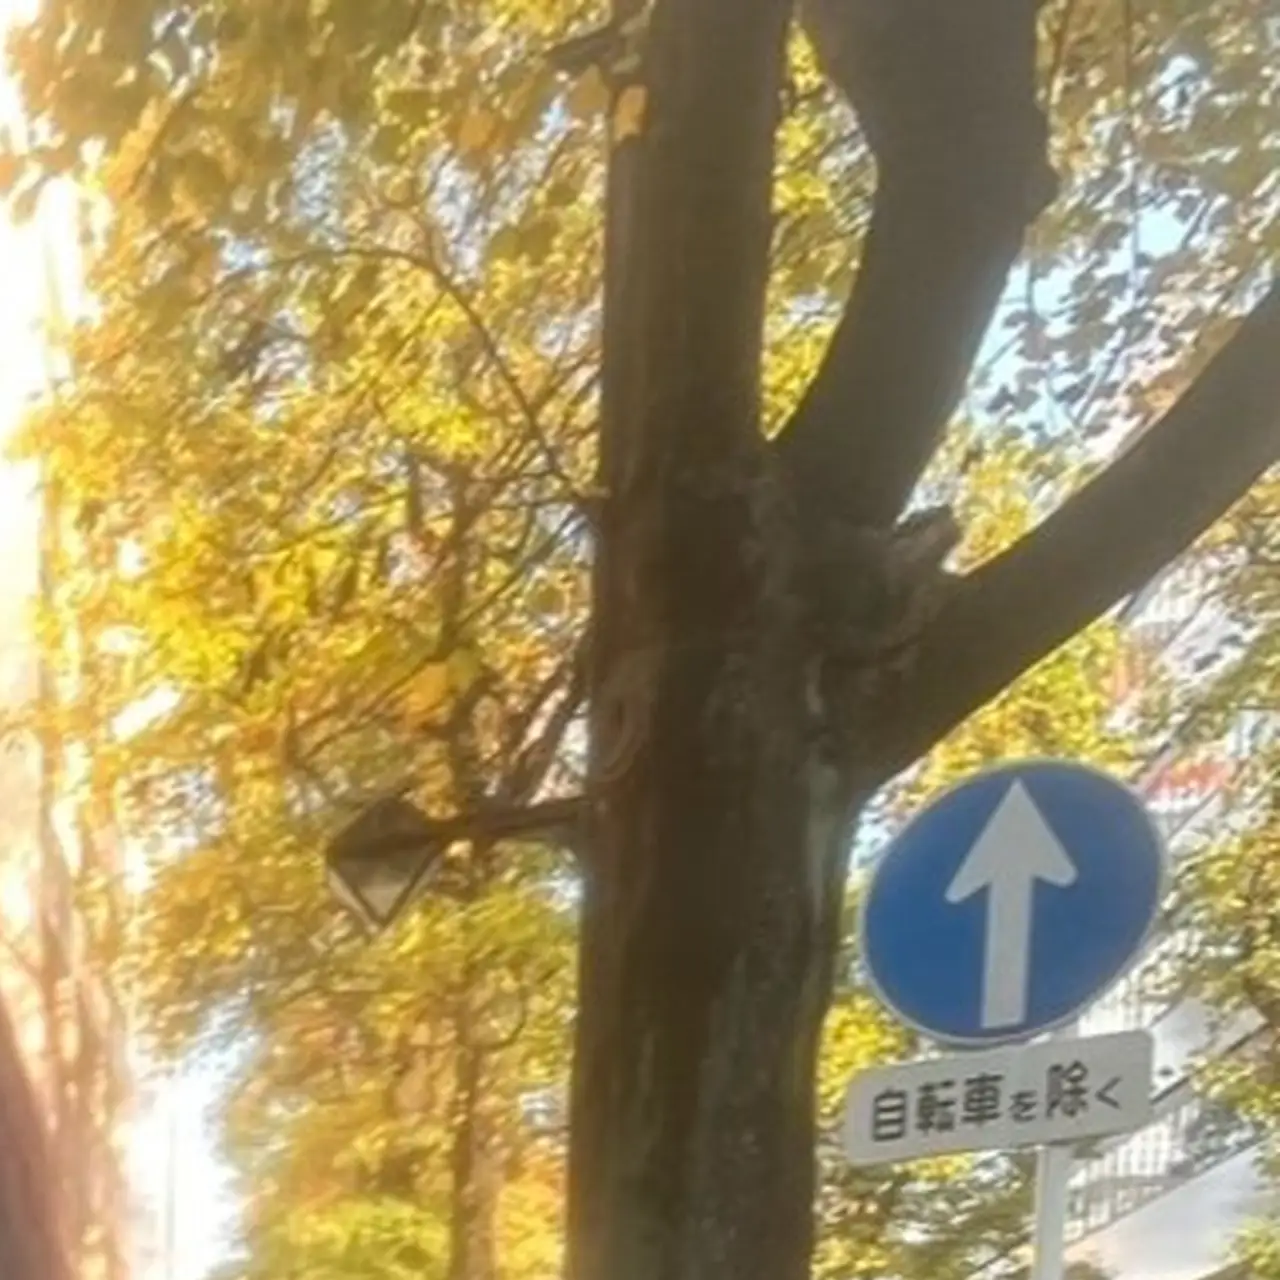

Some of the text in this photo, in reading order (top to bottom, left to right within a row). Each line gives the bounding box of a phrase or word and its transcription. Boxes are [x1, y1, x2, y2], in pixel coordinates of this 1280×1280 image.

[872, 1060, 1123, 1142] 自転車を除く
